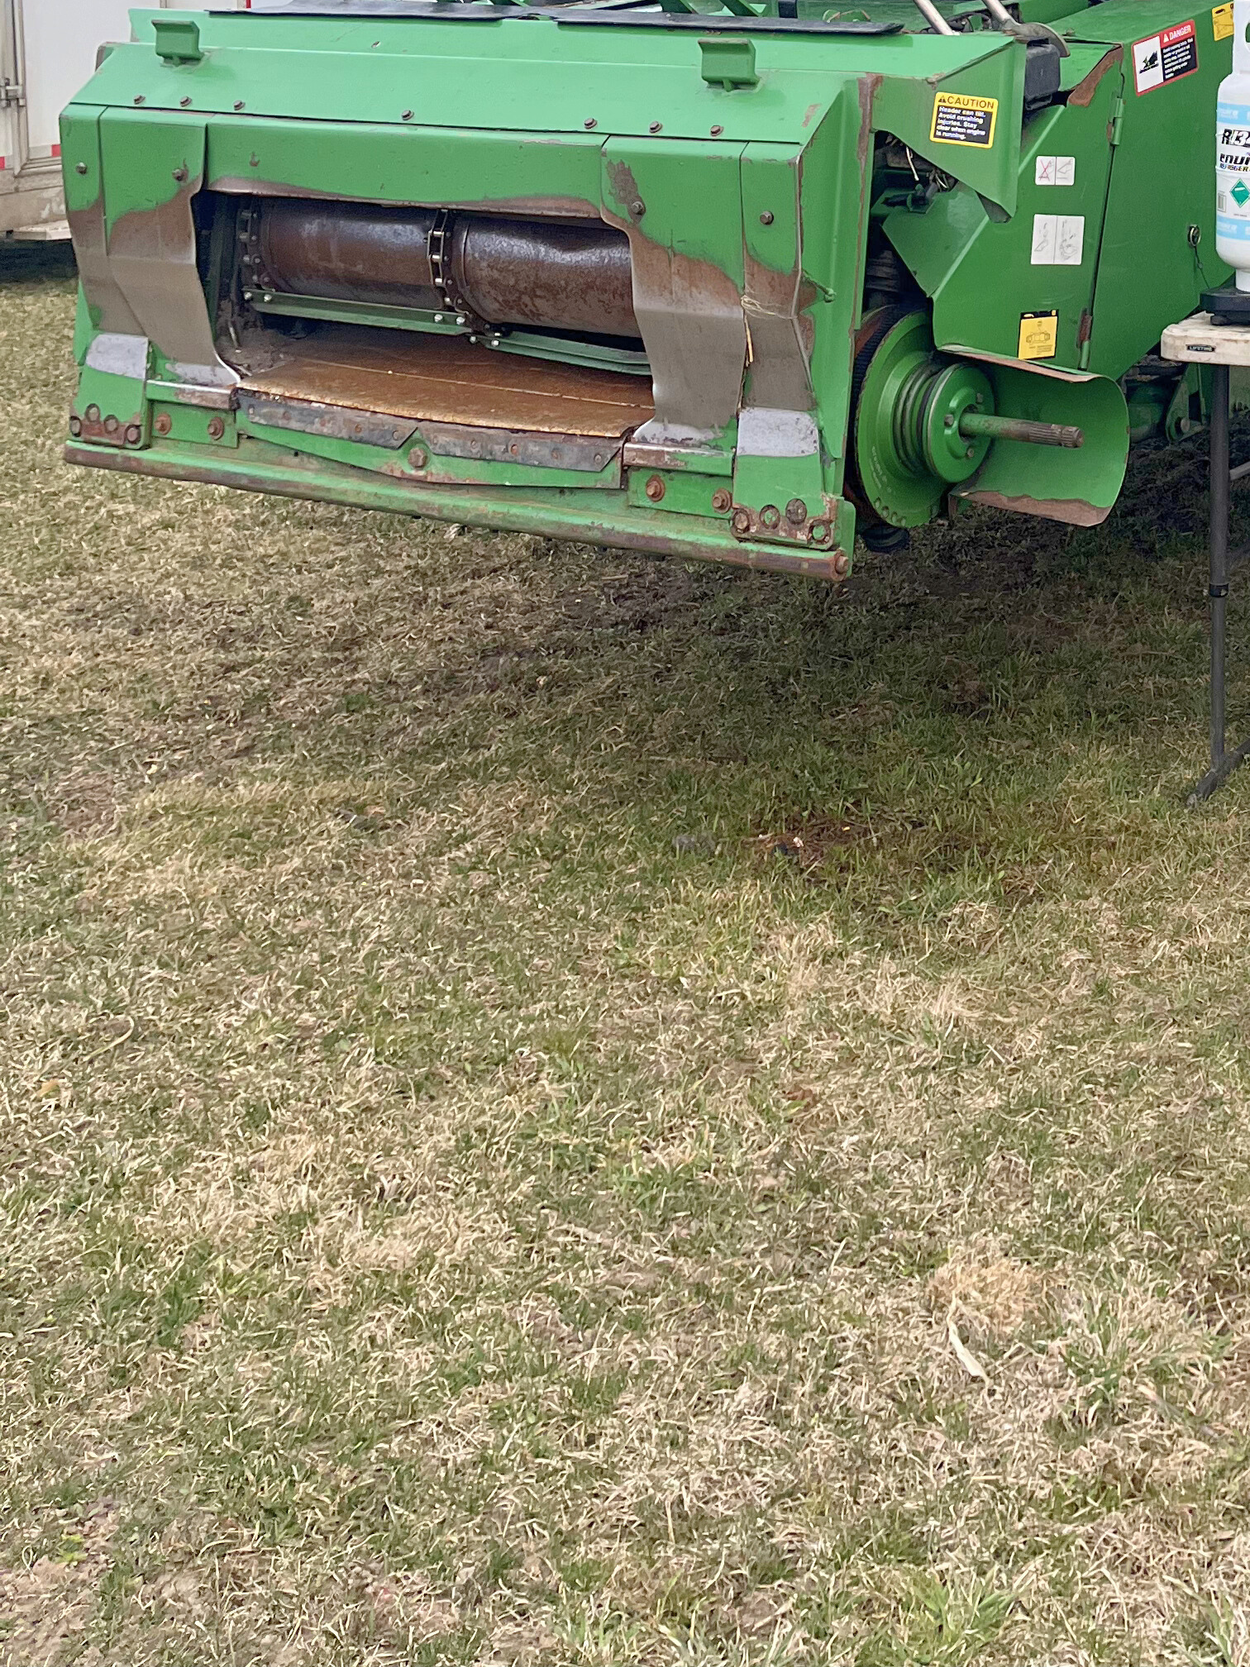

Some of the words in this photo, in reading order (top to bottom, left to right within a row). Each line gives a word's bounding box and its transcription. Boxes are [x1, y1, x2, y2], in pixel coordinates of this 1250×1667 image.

[1169, 25, 1191, 40] DANGER
[947, 96, 995, 109] CAUTION
[956, 116, 984, 124] crushing
[963, 121, 978, 130] Stay
